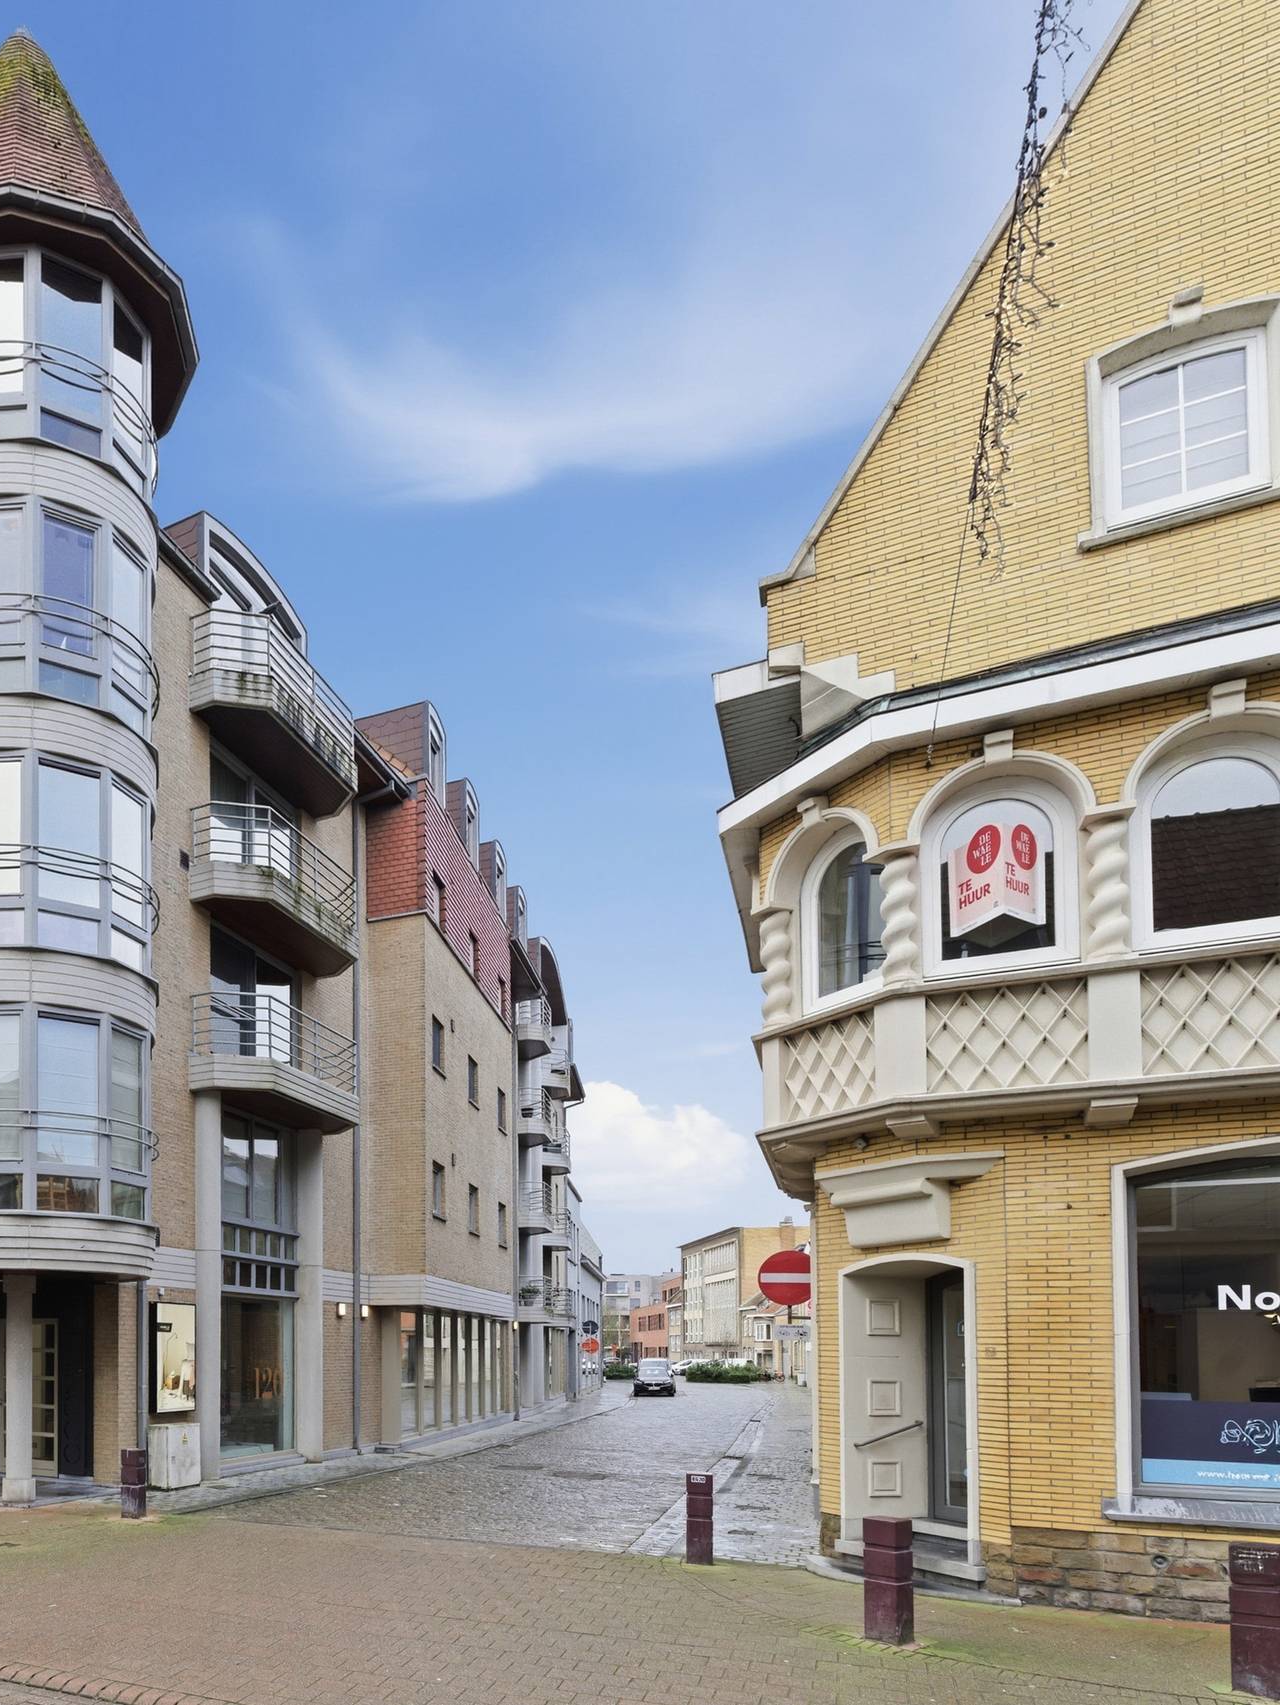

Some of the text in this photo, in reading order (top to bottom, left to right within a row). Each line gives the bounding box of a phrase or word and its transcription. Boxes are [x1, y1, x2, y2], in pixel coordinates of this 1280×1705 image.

[979, 831, 991, 845] DE
[1020, 831, 1030, 844] DE
[973, 842, 991, 859] WAE
[1015, 840, 1030, 855] WAE
[981, 852, 992, 866] LE
[1022, 852, 1030, 865] LE
[1005, 861, 1016, 876] TE
[959, 879, 972, 895] TE
[1005, 876, 1030, 896] HUUR
[959, 883, 991, 910] HUUR
[1217, 1284, 1280, 1311] No
